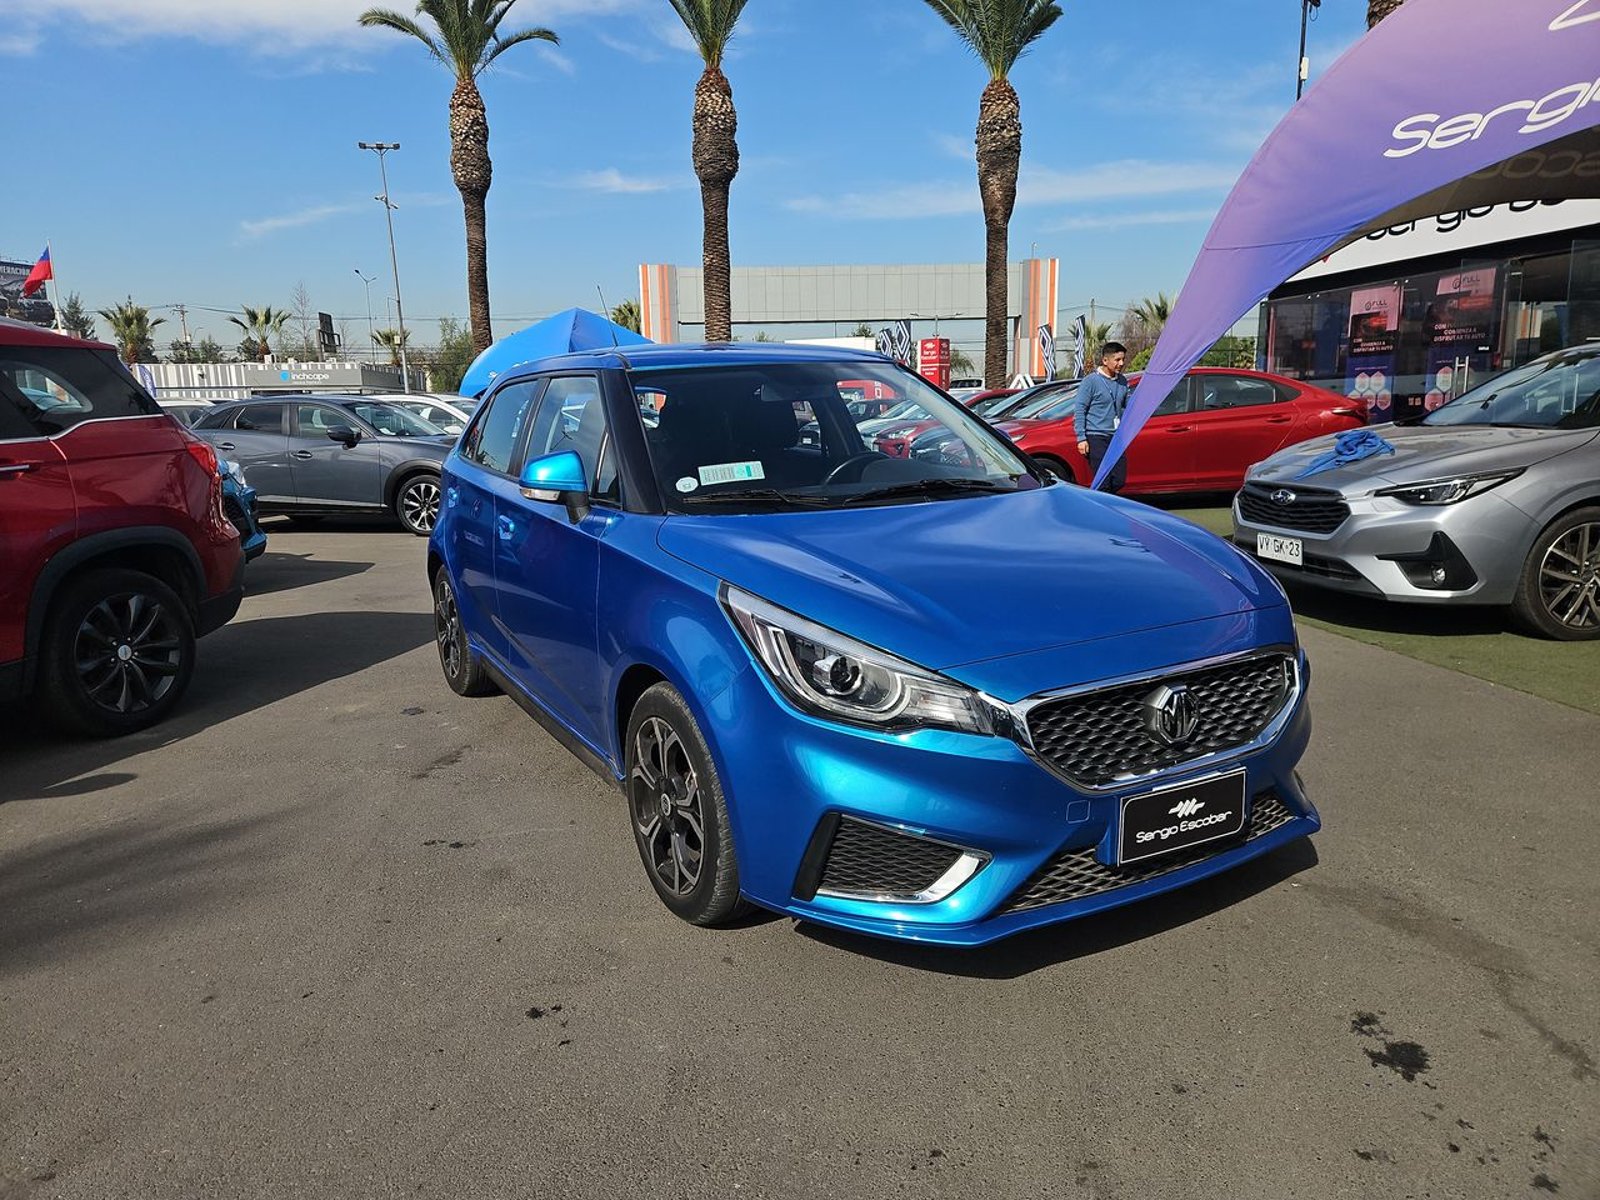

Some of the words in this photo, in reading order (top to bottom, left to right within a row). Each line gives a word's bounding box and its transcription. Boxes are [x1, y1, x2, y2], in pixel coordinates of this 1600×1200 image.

[1383, 77, 1600, 158] Sergi
[291, 372, 330, 381] inchcape
[1180, 811, 1232, 832] Escobar
